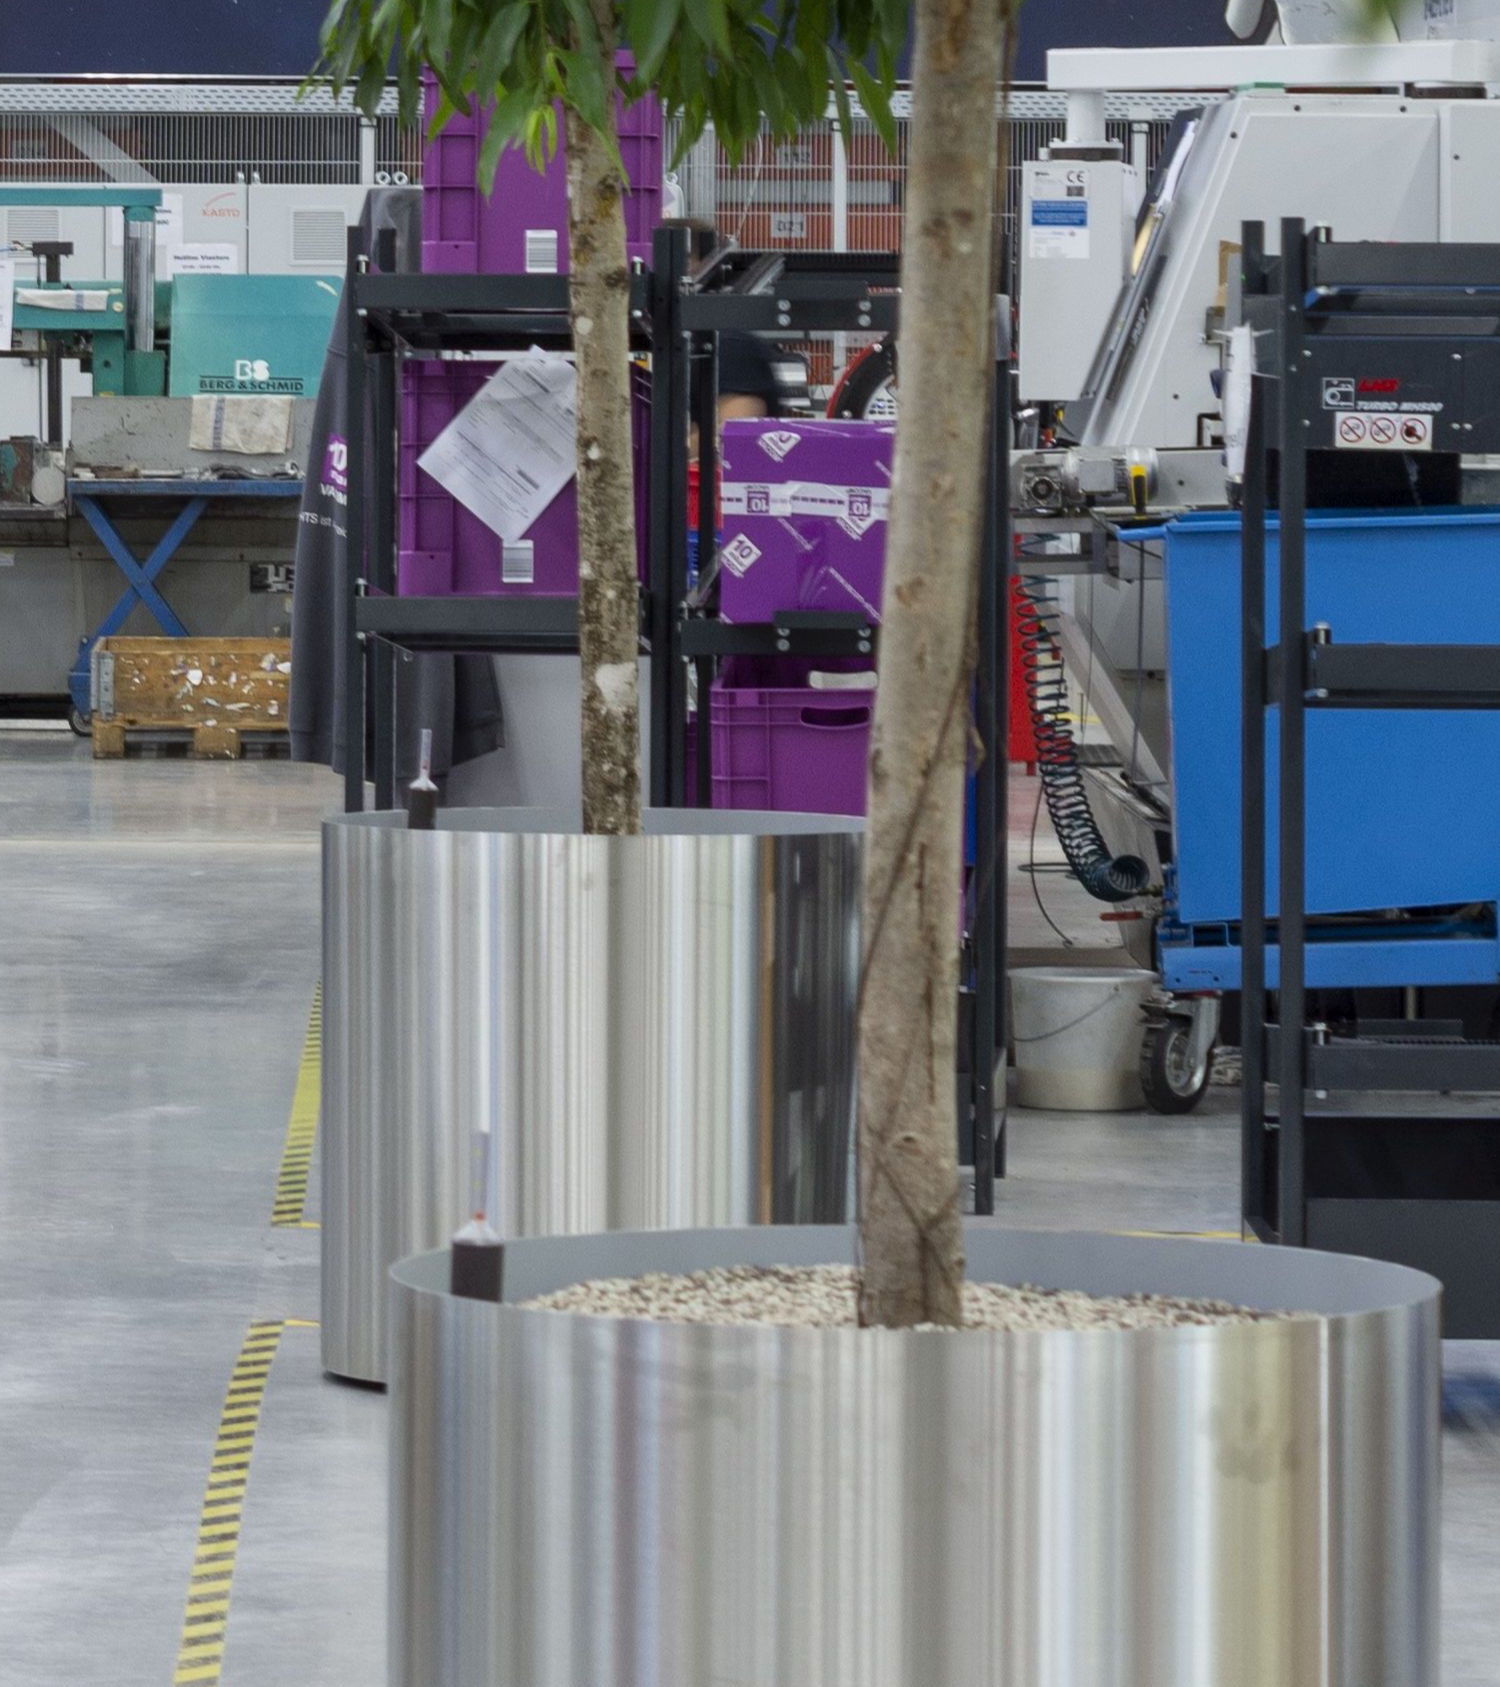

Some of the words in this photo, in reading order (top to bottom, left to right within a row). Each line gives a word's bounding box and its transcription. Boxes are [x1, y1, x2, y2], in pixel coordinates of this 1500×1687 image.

[199, 379, 235, 390] BERG
[238, 379, 248, 390] &
[249, 380, 304, 392] SCHMID
